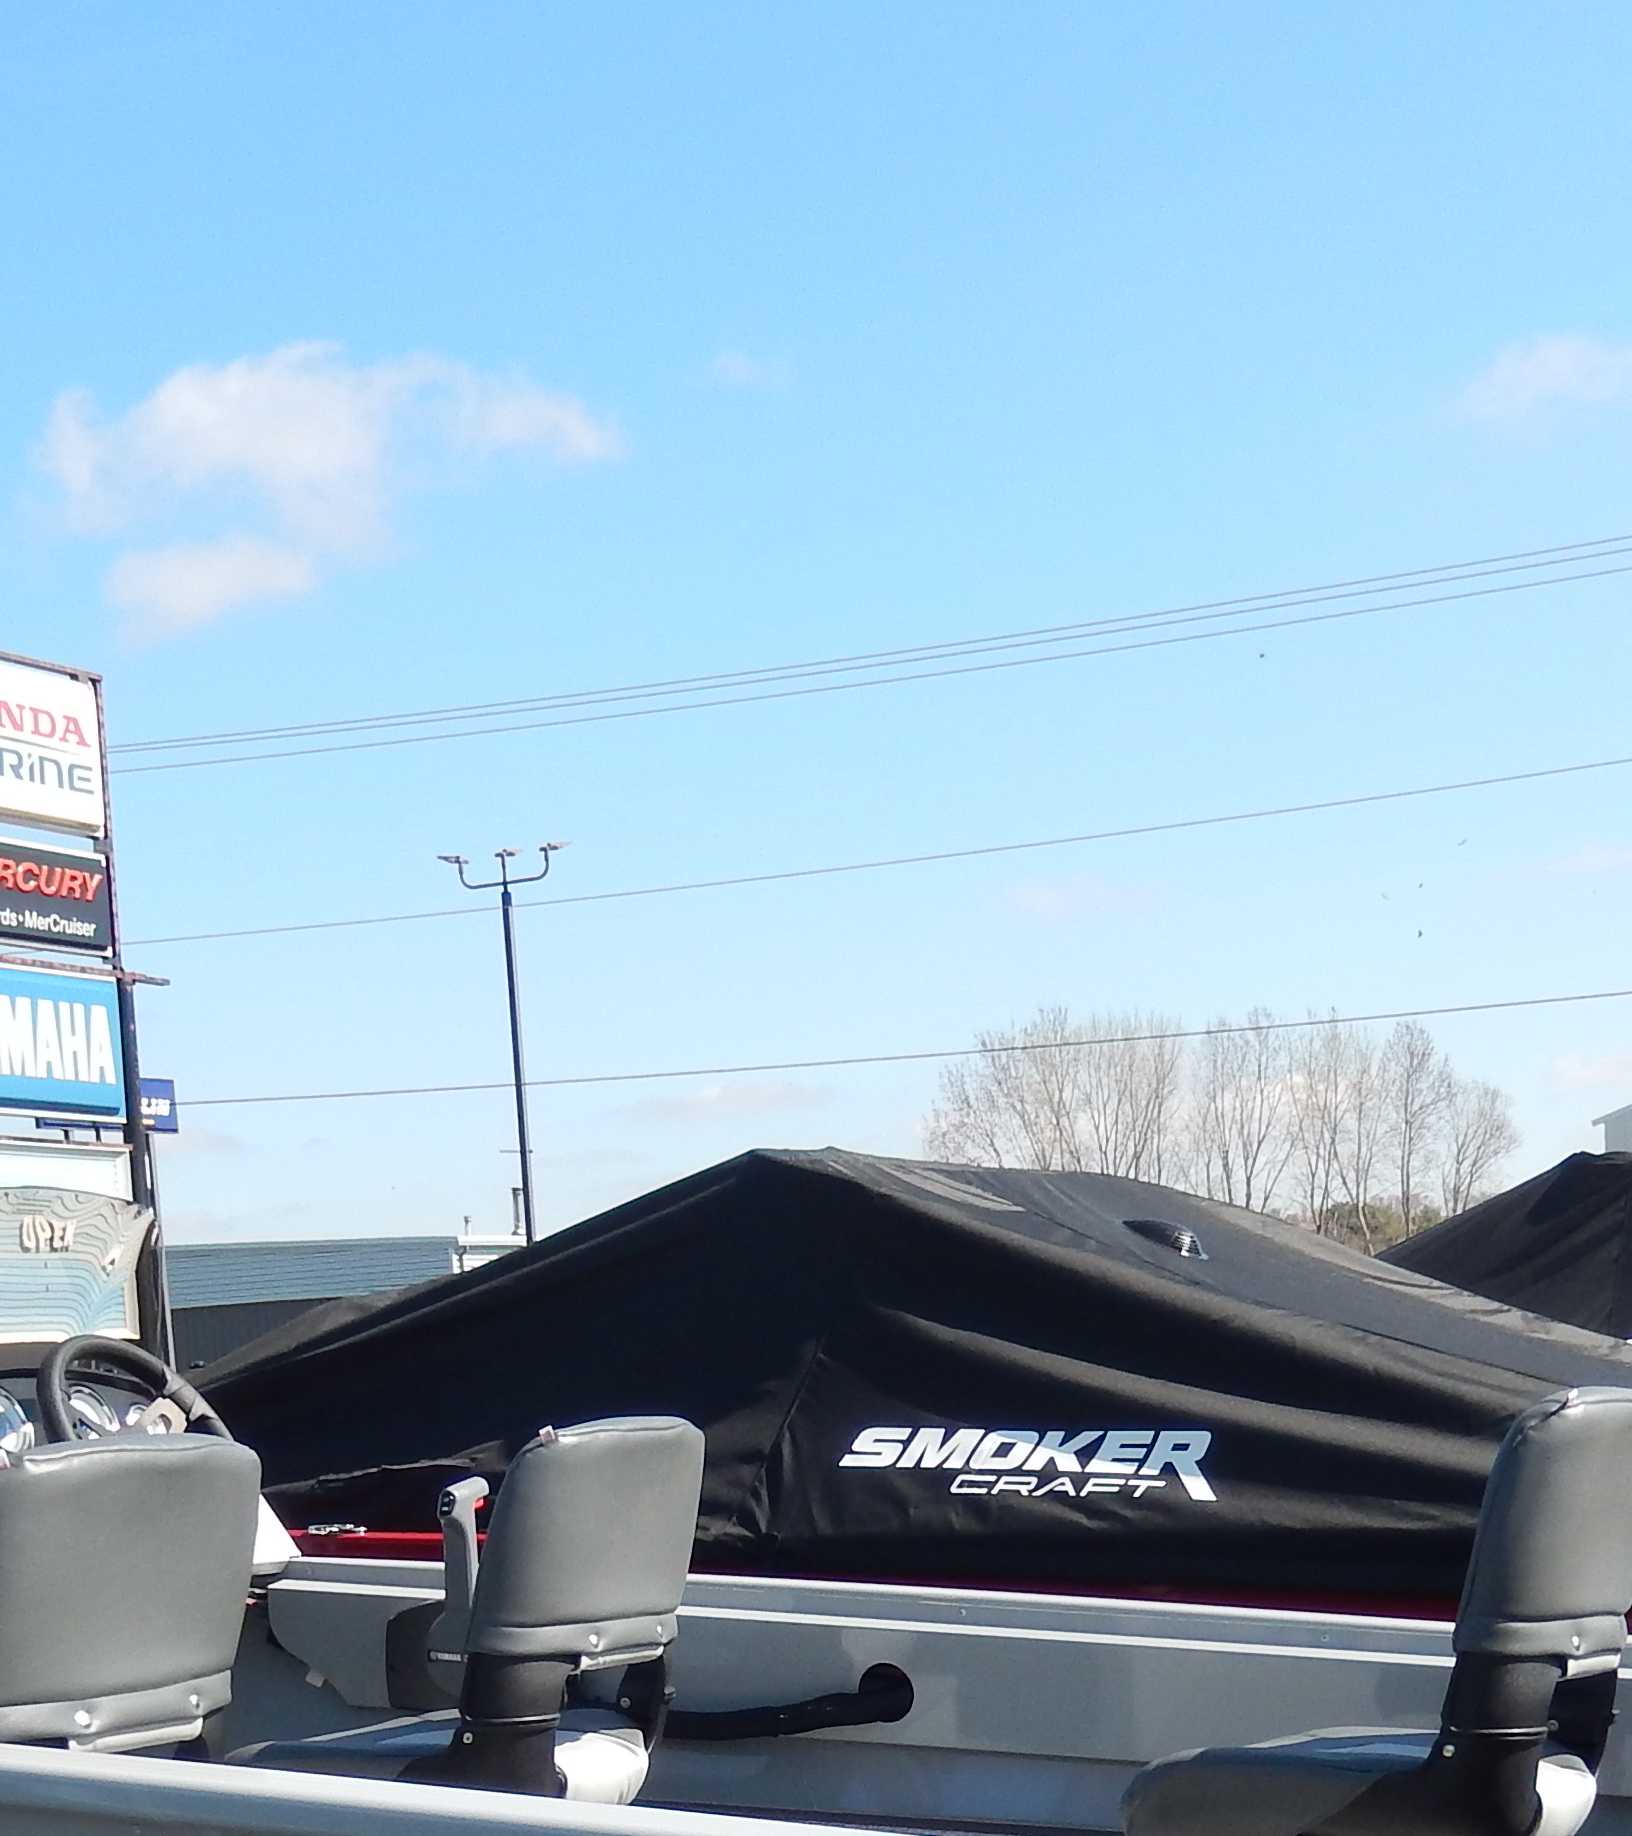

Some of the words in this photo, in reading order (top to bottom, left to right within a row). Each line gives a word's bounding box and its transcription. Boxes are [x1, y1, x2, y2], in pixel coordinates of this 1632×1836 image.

[24, 909, 97, 938] MerCruiser
[21, 1214, 78, 1253] OPEN
[838, 1427, 1218, 1501] SMOKER
[949, 1474, 1166, 1498] CRAFT
